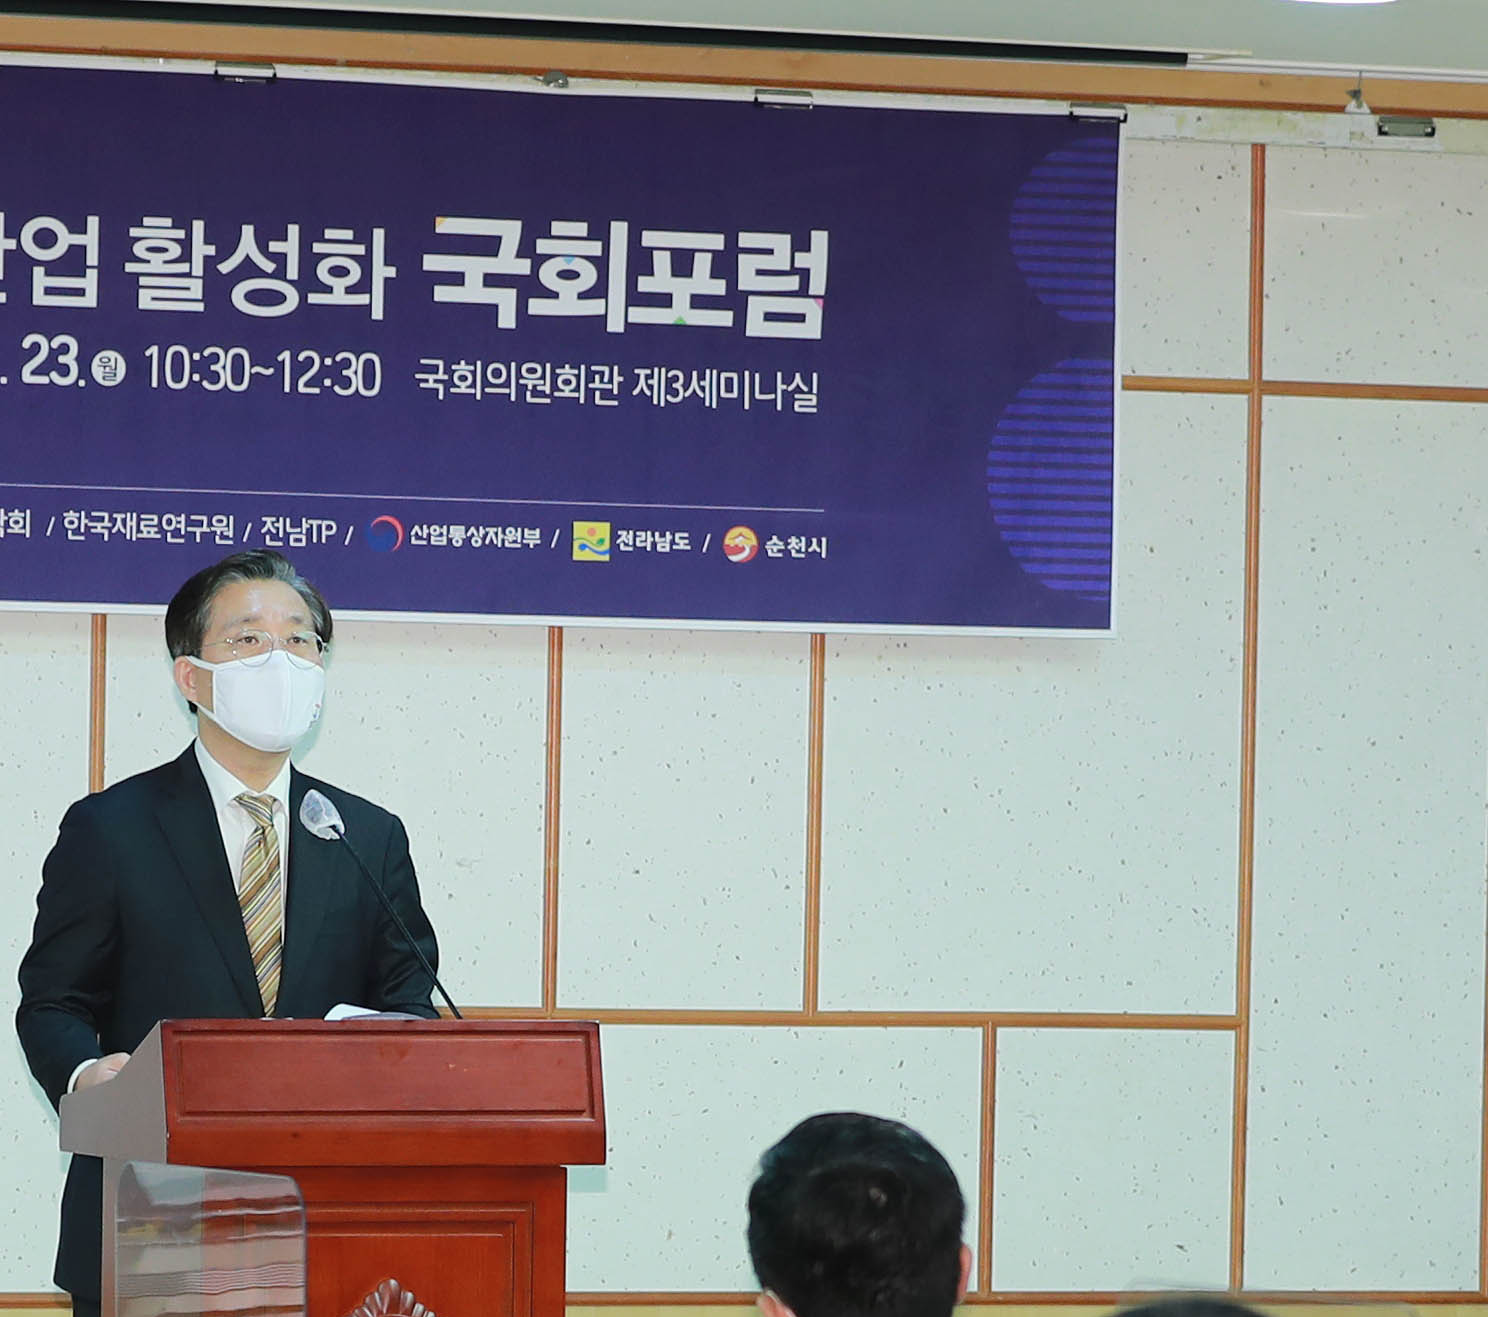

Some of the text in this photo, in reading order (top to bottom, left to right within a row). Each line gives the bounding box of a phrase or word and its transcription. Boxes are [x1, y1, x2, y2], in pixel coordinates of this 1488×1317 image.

[124, 216, 397, 321] 활성화
[423, 217, 829, 340] 국회포럼
[144, 345, 382, 397] 10:30~12:30
[414, 358, 624, 406] 국회의원회관
[633, 366, 818, 413] 제3세미나실
[62, 509, 235, 545] 한국재료연구원
[260, 516, 338, 547] 전남TP
[410, 524, 542, 549] 산업통상자원부
[616, 528, 692, 553] 전라남도
[764, 533, 827, 560] 순천시
